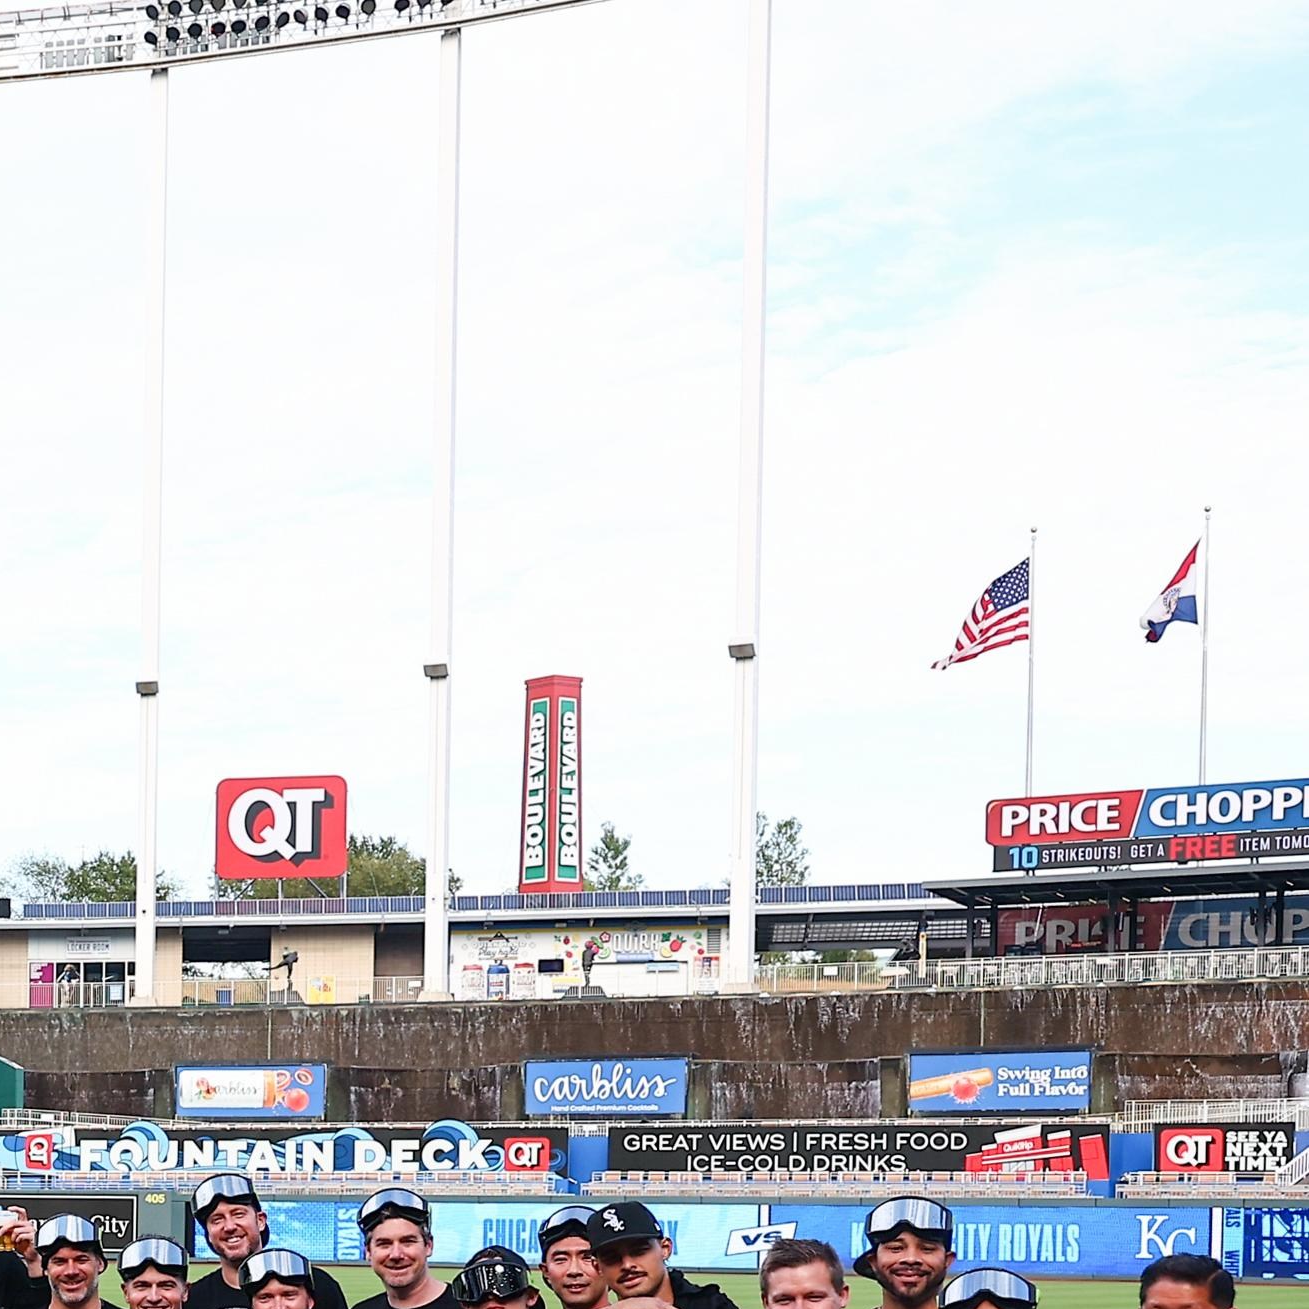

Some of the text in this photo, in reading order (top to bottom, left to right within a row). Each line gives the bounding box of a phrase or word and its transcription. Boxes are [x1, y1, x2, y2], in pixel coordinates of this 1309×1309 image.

[524, 711, 545, 866] BOULEVARD
[559, 711, 578, 866] BOULEVARD
[227, 788, 326, 861] QT
[1000, 786, 1309, 837] PRICE CHOPP
[1009, 846, 1039, 869] 10
[1042, 846, 1122, 863] STRIKEOUTS!
[1130, 844, 1154, 859] GET
[1156, 843, 1165, 857] A
[1169, 835, 1236, 860] FREE
[1240, 837, 1270, 852] ITEM
[533, 1063, 676, 1102] carbliss
[997, 1065, 1088, 1084] Swing Into
[997, 1082, 1088, 1097] Full Flavor
[623, 1133, 968, 1151] GREAT VIEWS FRESH FOOD
[1166, 1135, 1211, 1167] QT
[1226, 1131, 1288, 1142] SEE YA
[1226, 1142, 1287, 1157] NEXT
[80, 1139, 544, 1172] FOUNTAIN DECK QT
[686, 1154, 907, 1172] ICE-COLD DRINKS
[1226, 1156, 1286, 1172] TIME!
[144, 1194, 164, 1205] 405
[997, 1223, 1080, 1262] ROYALS
